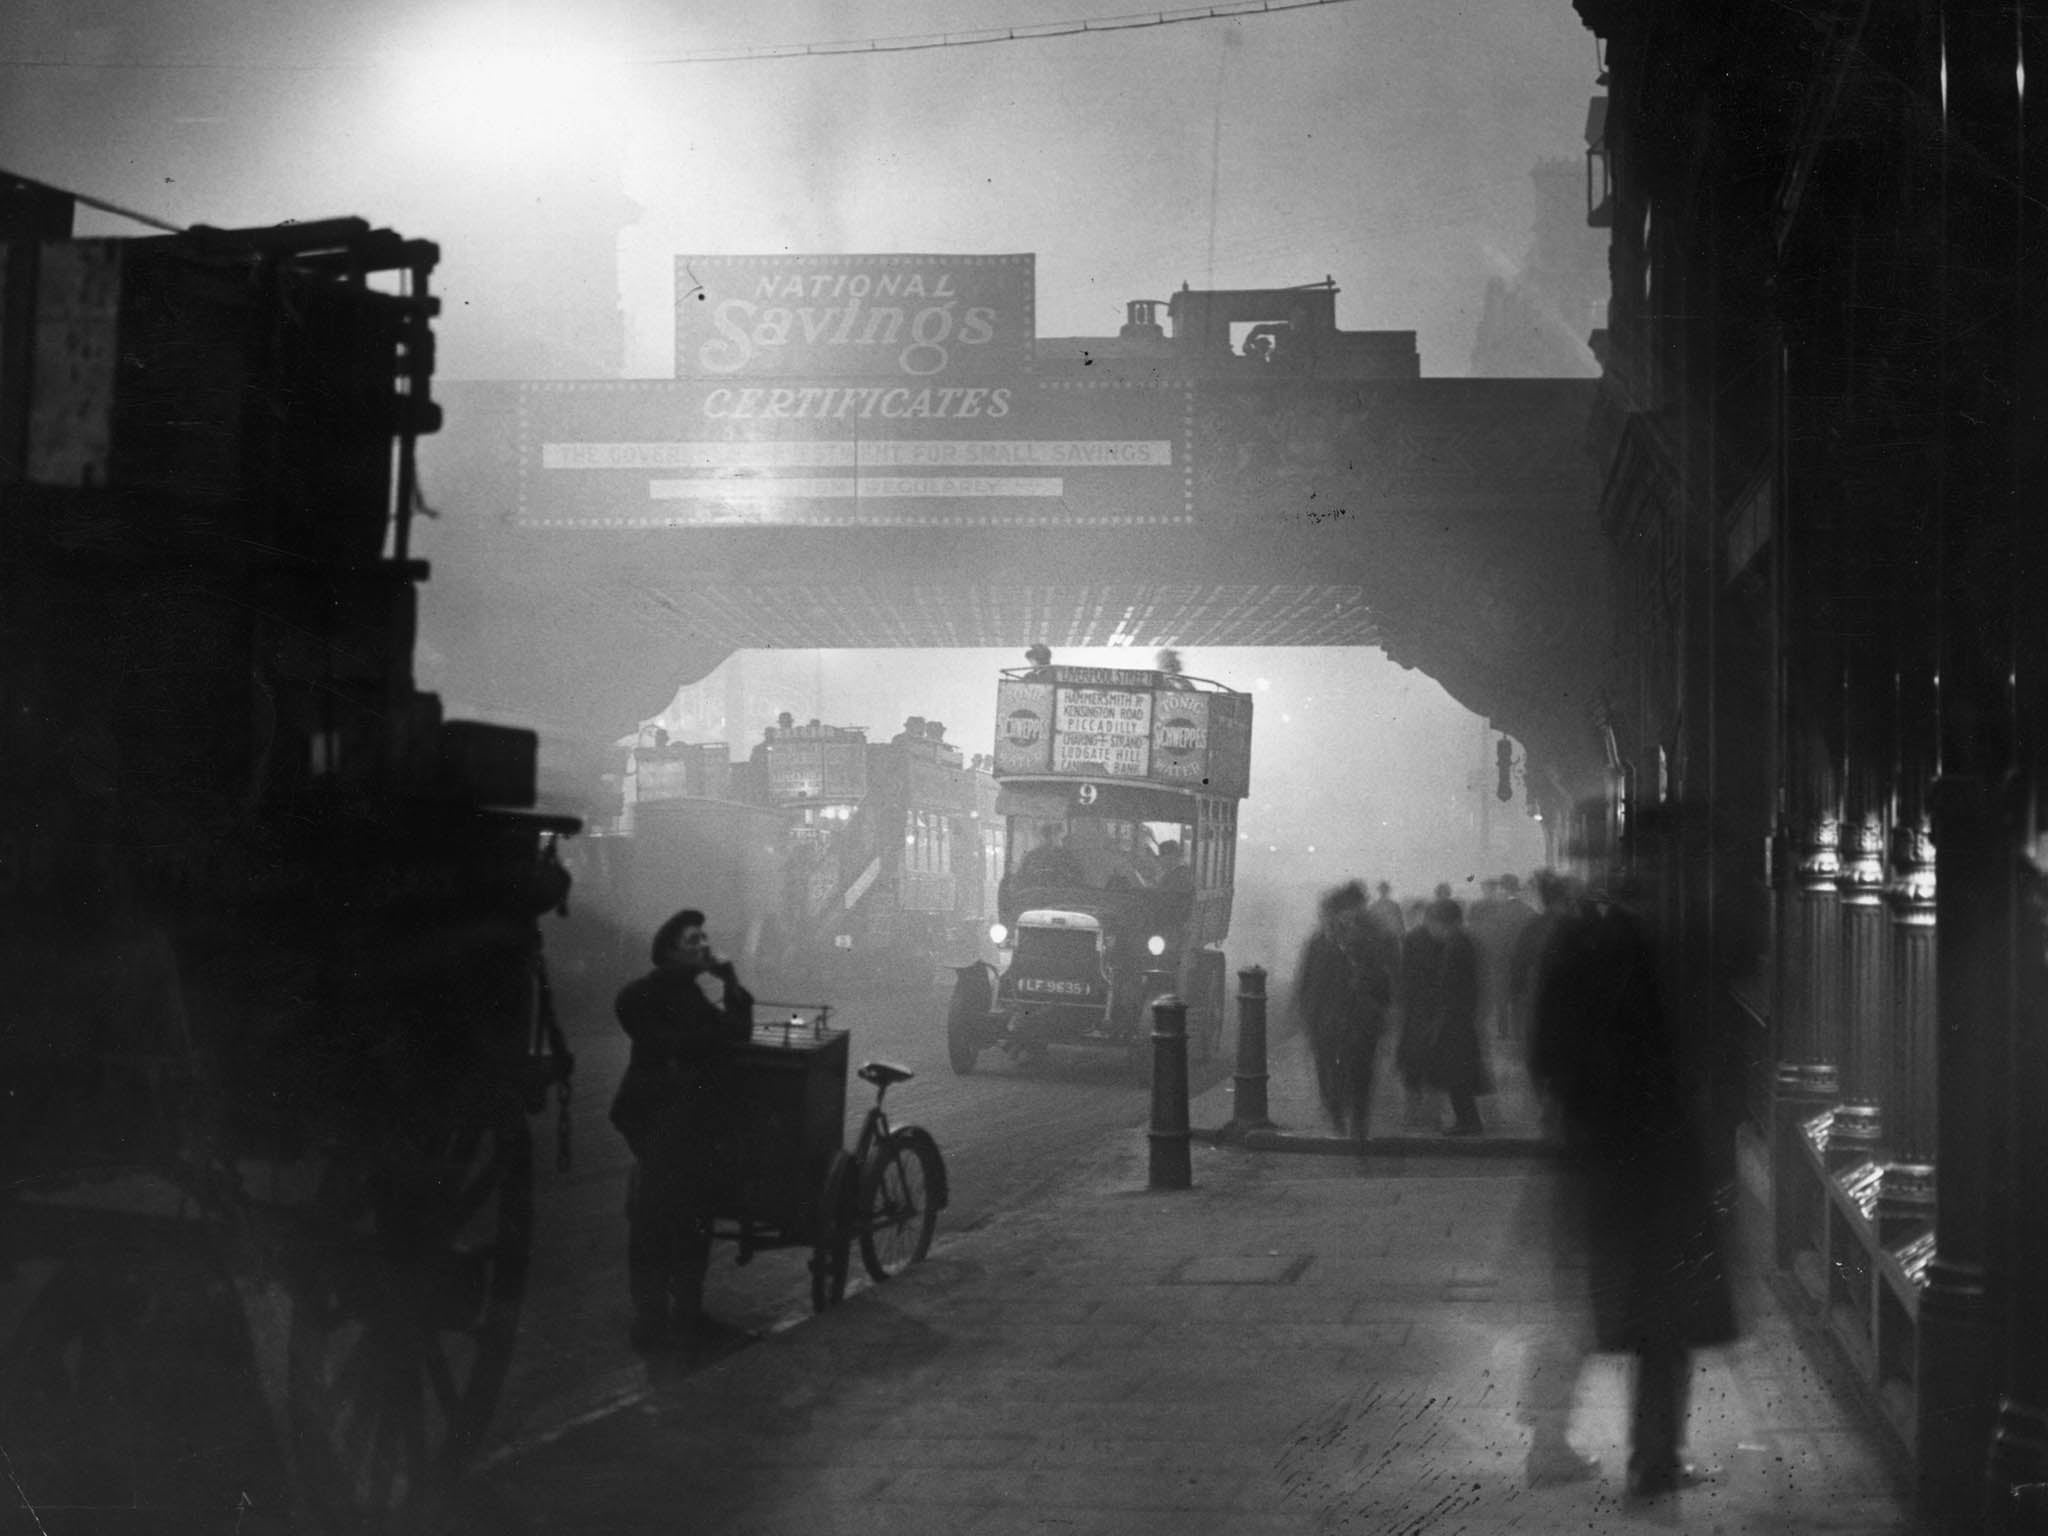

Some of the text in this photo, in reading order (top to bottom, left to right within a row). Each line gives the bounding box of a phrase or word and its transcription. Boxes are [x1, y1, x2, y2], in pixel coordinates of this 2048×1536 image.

[756, 274, 956, 298] NATIONAL
[699, 299, 997, 375] Savings
[702, 386, 1012, 421] CERTIFICATES
[560, 445, 599, 463] THE
[913, 444, 957, 462] FOR
[965, 444, 1035, 462] SMALL
[1053, 444, 1151, 462] SAVINGS
[1064, 691, 1132, 707] HAMMERSMITH
[1162, 696, 1204, 714] TONIC
[1064, 705, 1144, 721] KENSINGTON ROAD
[1068, 718, 1138, 734] PICCADILLY
[1153, 722, 1208, 750] SCHWEPPES
[1061, 746, 1141, 761] LUDGATE HILL
[1079, 783, 1097, 805] 9
[1026, 979, 1044, 991] LF
